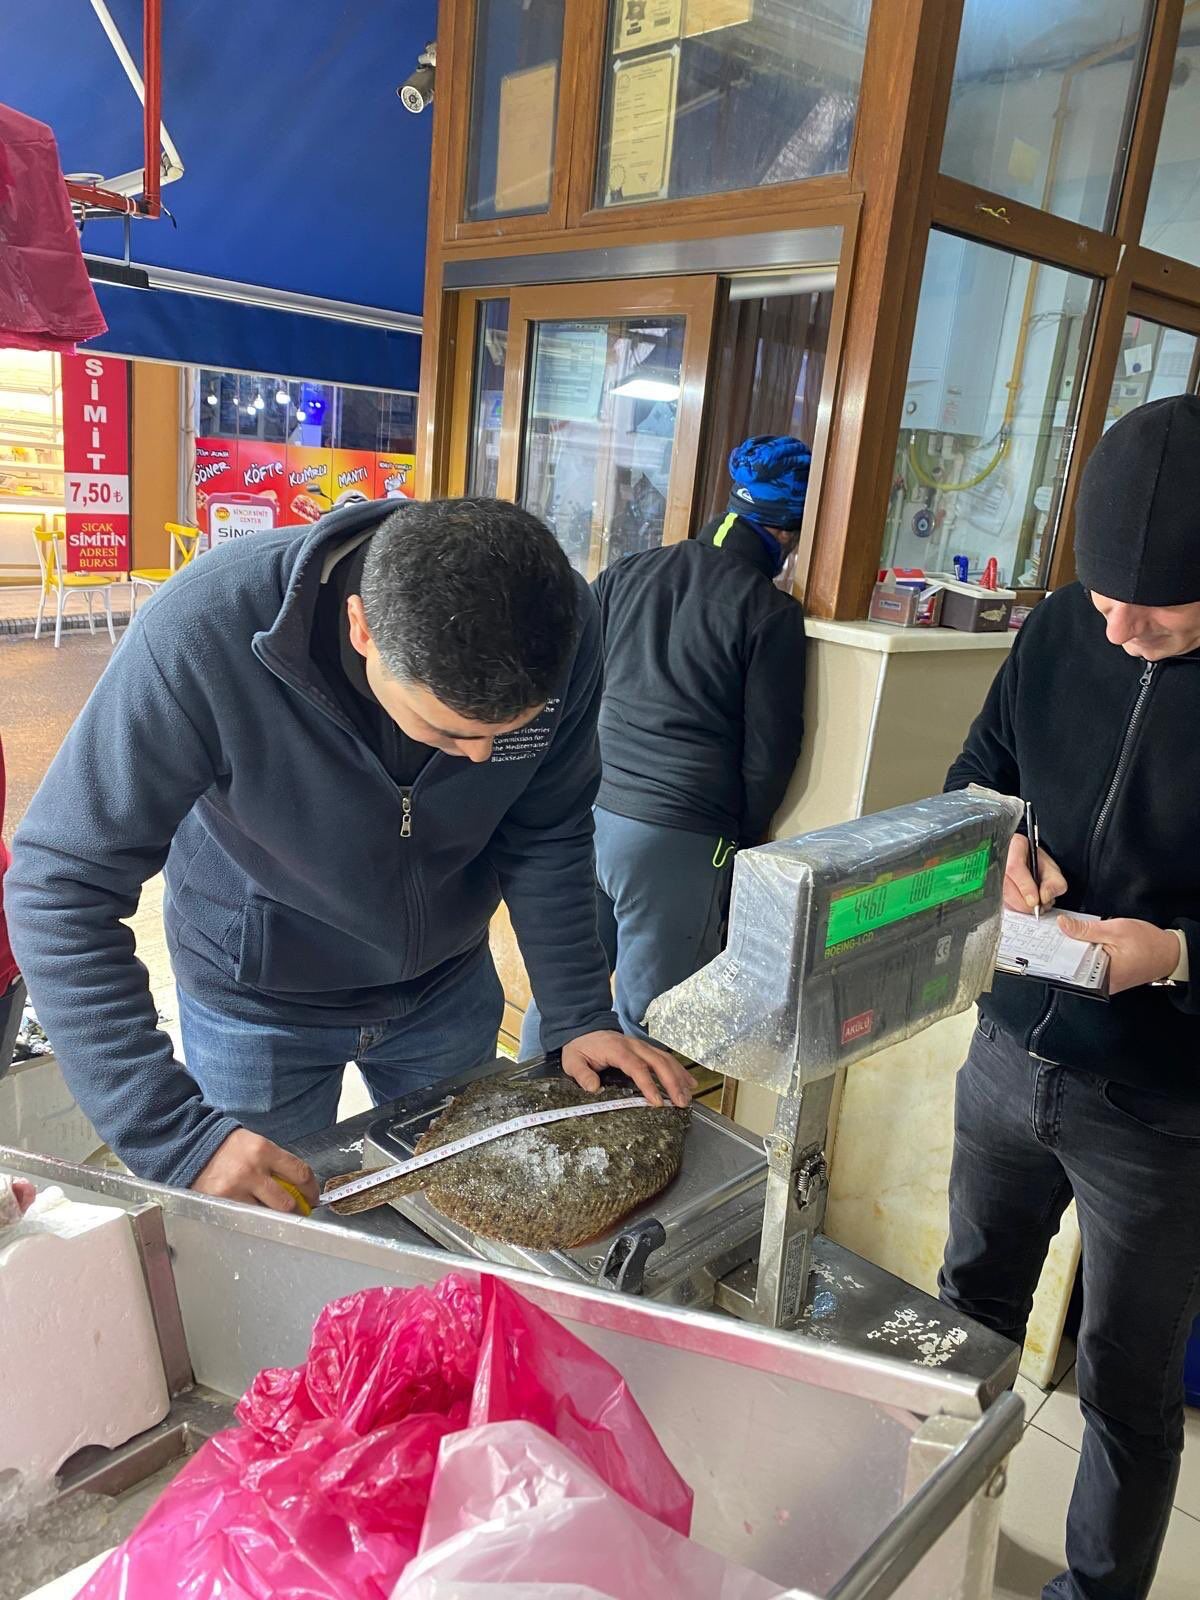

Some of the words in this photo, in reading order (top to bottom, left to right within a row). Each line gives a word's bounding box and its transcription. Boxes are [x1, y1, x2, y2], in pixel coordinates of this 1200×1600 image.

[83, 358, 107, 470] SİMİT
[338, 466, 368, 488] MANTI
[81, 523, 113, 531] SICAK
[69, 532, 126, 547] SİMİTİN
[79, 546, 118, 557] ADRESİ
[79, 558, 117, 567] BURASI
